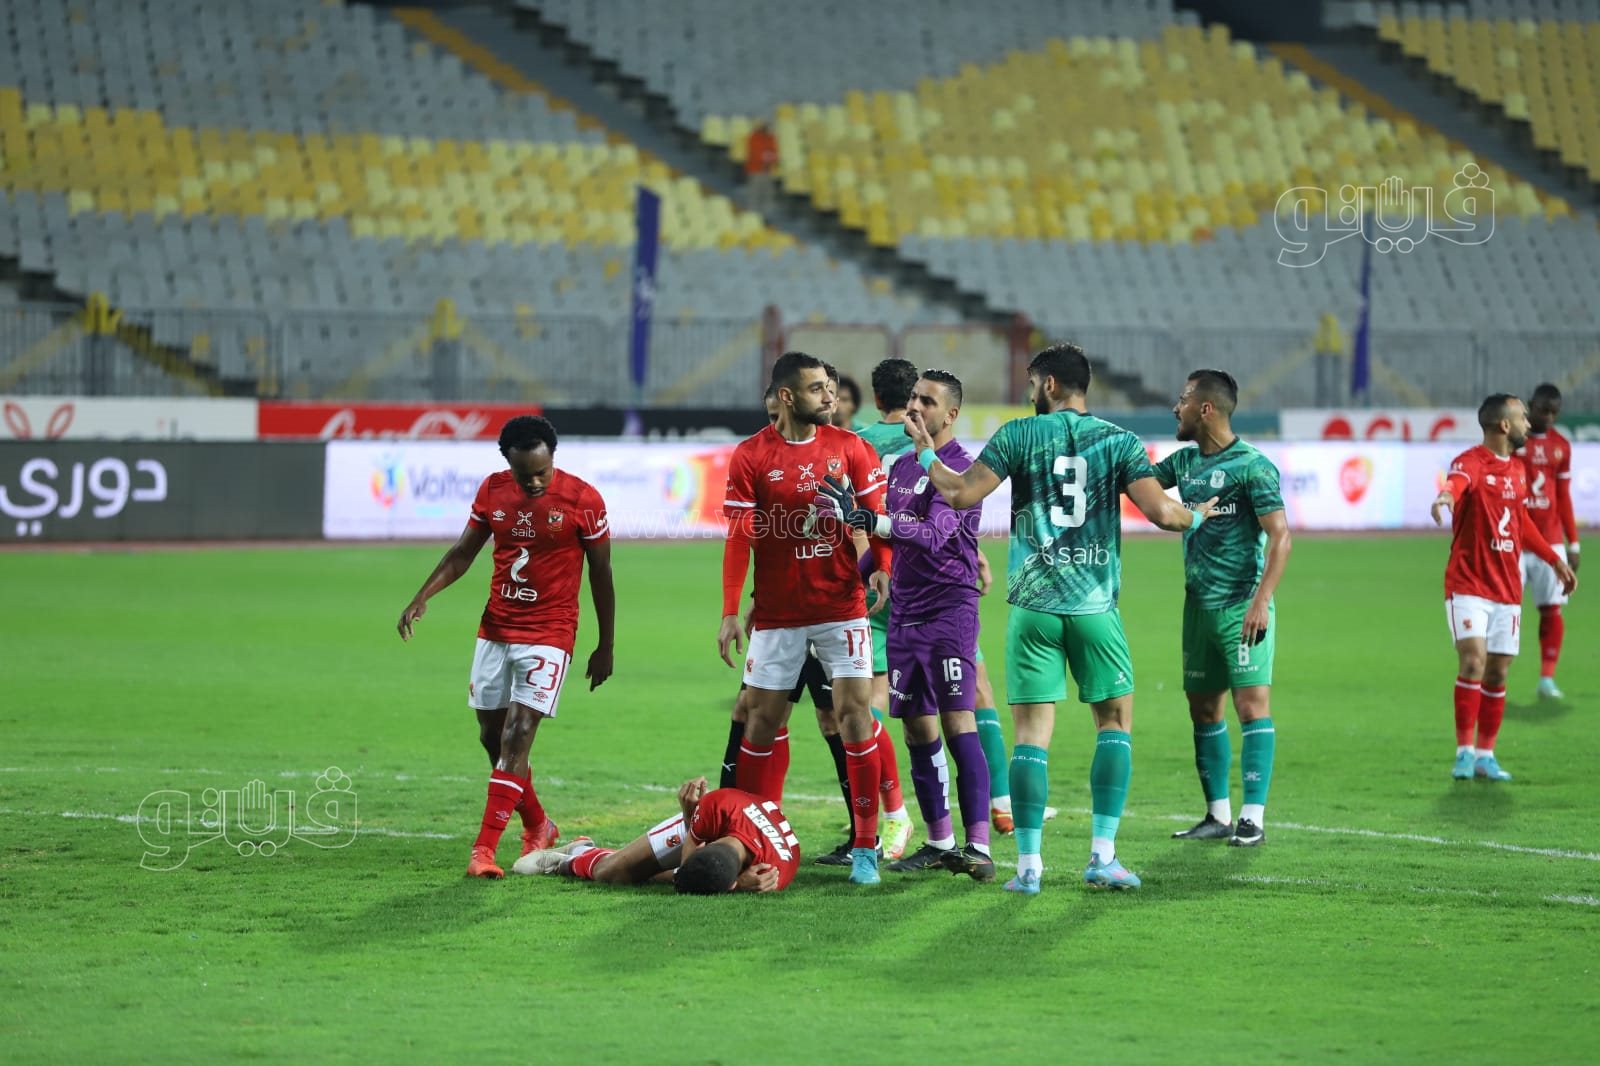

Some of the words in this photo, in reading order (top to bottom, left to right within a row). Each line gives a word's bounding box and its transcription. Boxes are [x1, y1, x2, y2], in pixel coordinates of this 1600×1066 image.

[0, 457, 168, 537] دوري
[1050, 456, 1088, 528] 3
[511, 526, 536, 538] saib
[795, 544, 833, 560] we
[1058, 544, 1110, 566] saib
[501, 583, 538, 602] we
[844, 629, 866, 658] 17
[1238, 643, 1249, 666] 8
[525, 655, 560, 691] 23
[942, 657, 963, 682] 16
